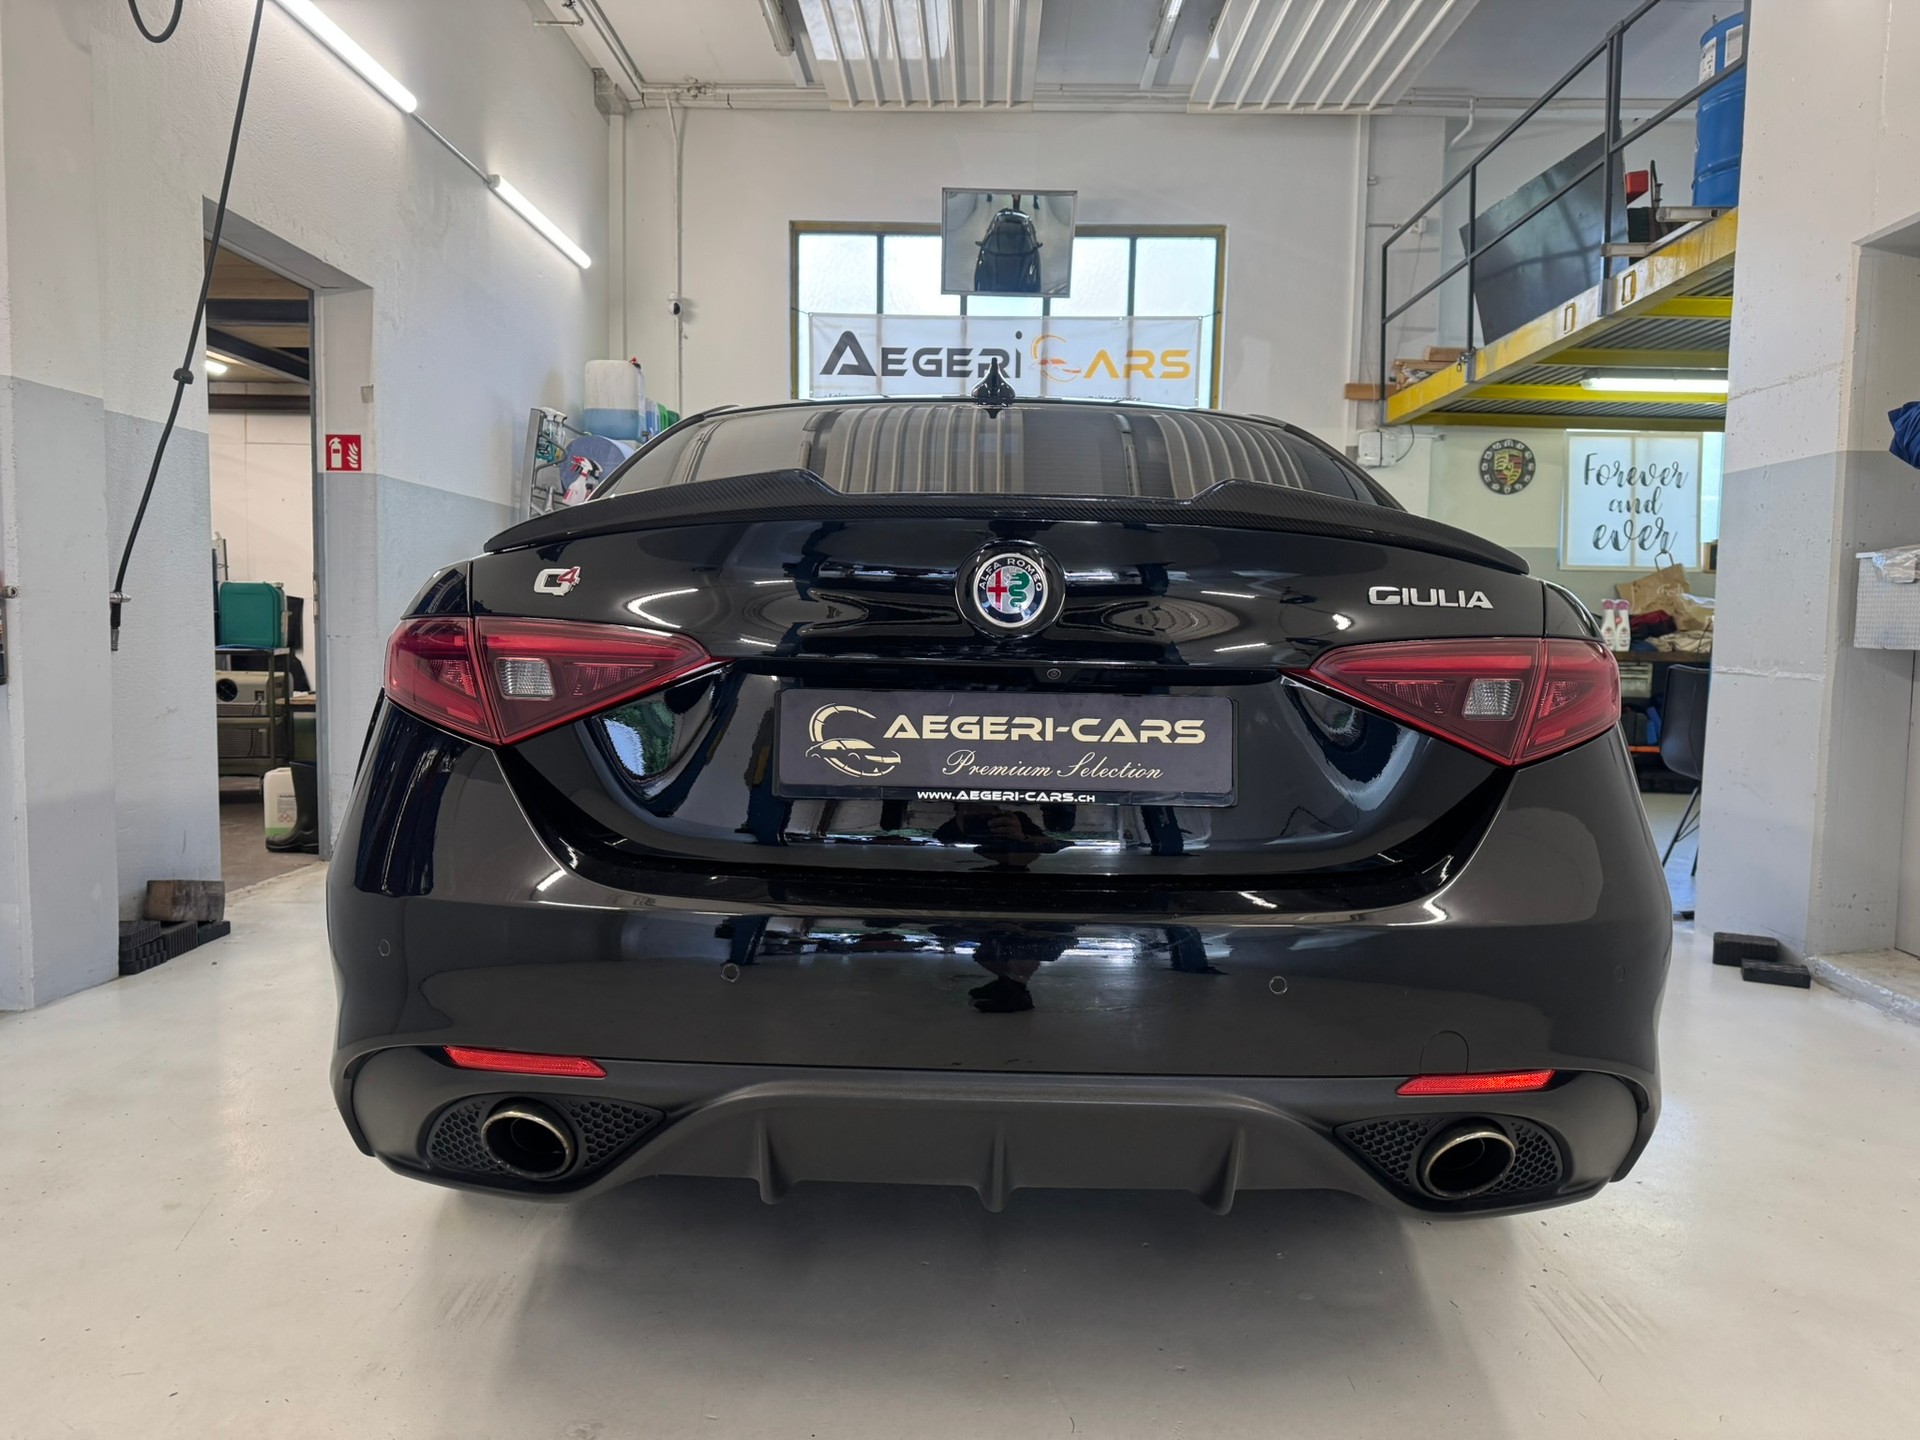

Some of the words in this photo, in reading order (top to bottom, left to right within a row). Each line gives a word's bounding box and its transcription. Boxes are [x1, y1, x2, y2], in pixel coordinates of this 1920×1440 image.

[1584, 452, 1689, 489] Forever
[1608, 486, 1663, 515] and
[1592, 516, 1679, 553] ever
[533, 566, 581, 596] Q4
[979, 561, 1001, 590] ALFA
[1007, 557, 1043, 592] ROMEO
[1368, 586, 1494, 609] GIULIA
[883, 714, 1206, 744] AEGERI-CARS
[942, 749, 1053, 777] Premium
[1057, 751, 1164, 780] Selection
